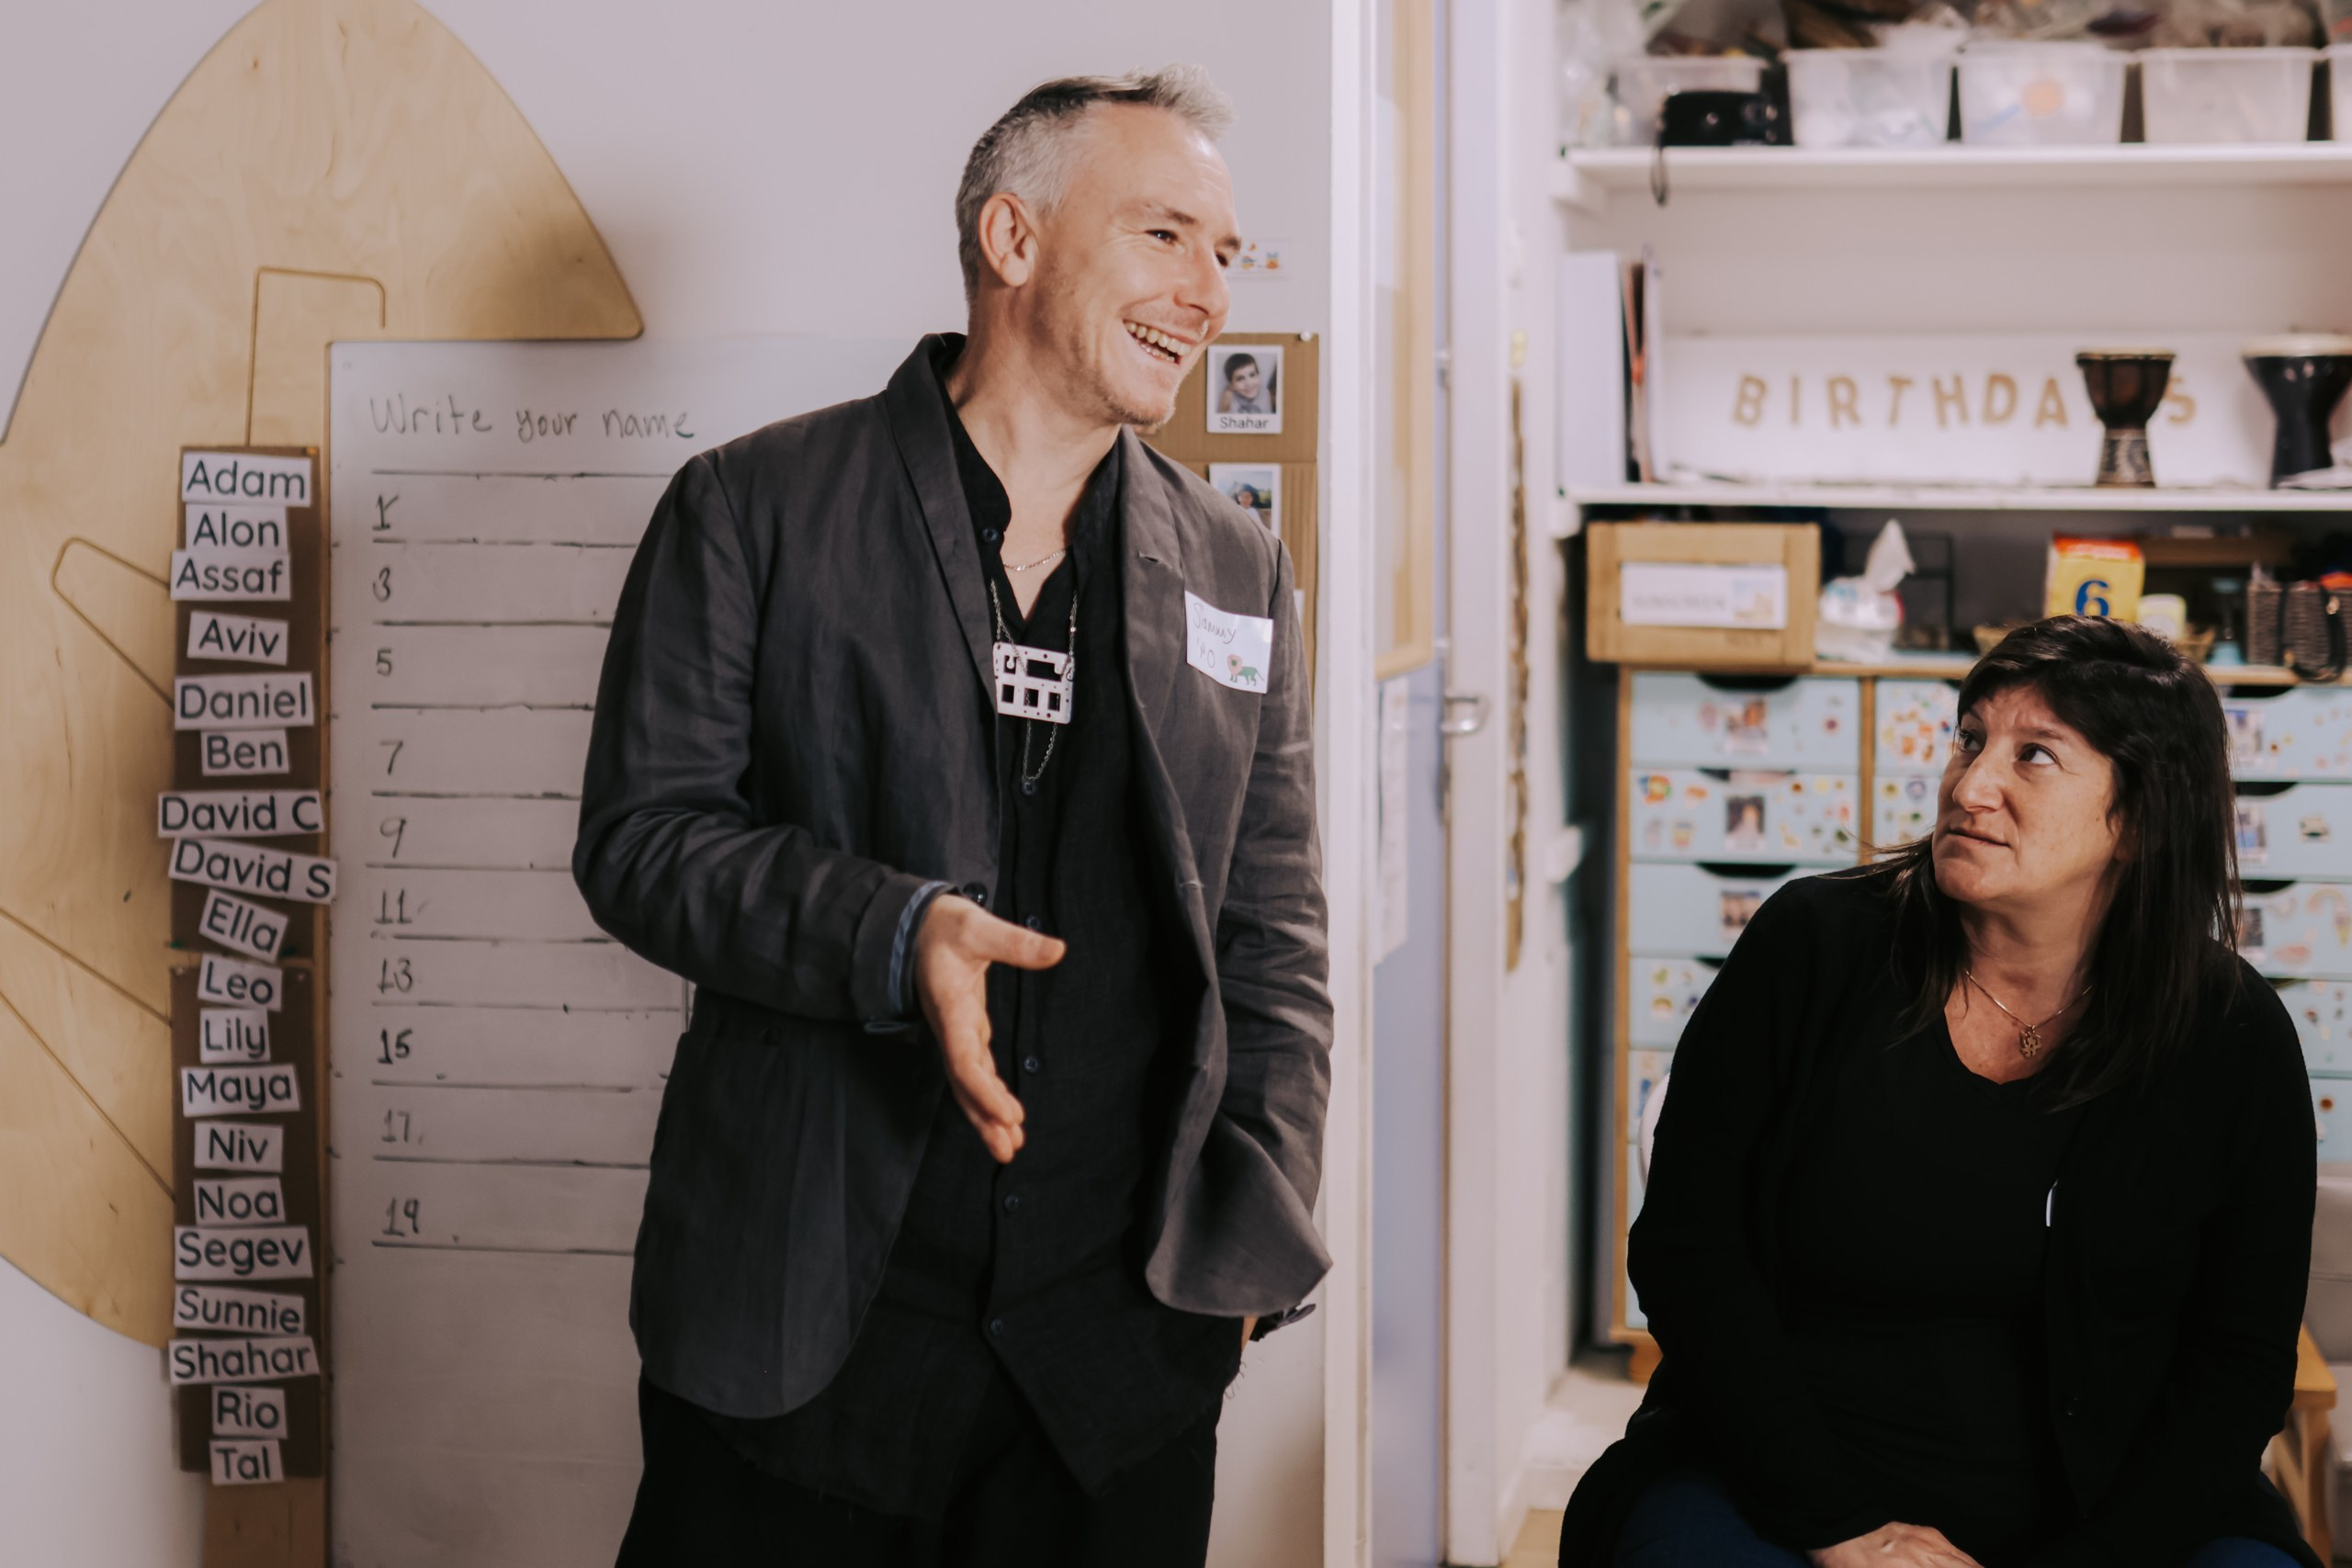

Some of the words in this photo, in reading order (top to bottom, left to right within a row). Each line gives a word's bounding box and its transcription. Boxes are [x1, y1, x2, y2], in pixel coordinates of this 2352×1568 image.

[370, 393, 492, 434] Write
[516, 409, 577, 443] your
[603, 409, 695, 438] name
[1732, 374, 2196, 428] BIRTHDAS
[1219, 416, 1269, 430] Shahar
[186, 459, 306, 499] Adam
[193, 511, 279, 547] Alon
[175, 557, 284, 593] Assaf
[372, 567, 391, 602] 3
[2075, 579, 2109, 617] 6
[198, 617, 279, 657] Aviv
[375, 649, 392, 676] 5
[179, 681, 307, 719] Daniel
[206, 734, 283, 770] Ben
[379, 739, 404, 775] 7
[161, 795, 277, 831] David
[291, 795, 319, 831] C
[379, 818, 407, 858] 9
[175, 838, 292, 897] David
[306, 863, 332, 898] S
[374, 888, 413, 925] 11
[207, 897, 278, 955] Ella
[204, 961, 274, 1005] Leo
[376, 956, 413, 994] 13
[204, 1018, 266, 1059] Lily
[377, 1027, 413, 1065] 15
[187, 1070, 292, 1110] Maya
[380, 1109, 412, 1143] 17
[209, 1128, 268, 1165] Niv
[198, 1187, 278, 1220] Noa
[381, 1197, 420, 1237] 19
[178, 1232, 304, 1275] Segev
[177, 1290, 300, 1335] Sunnie
[174, 1342, 310, 1381] Shahar
[216, 1392, 280, 1430] Rio
[215, 1446, 270, 1483] Tal
